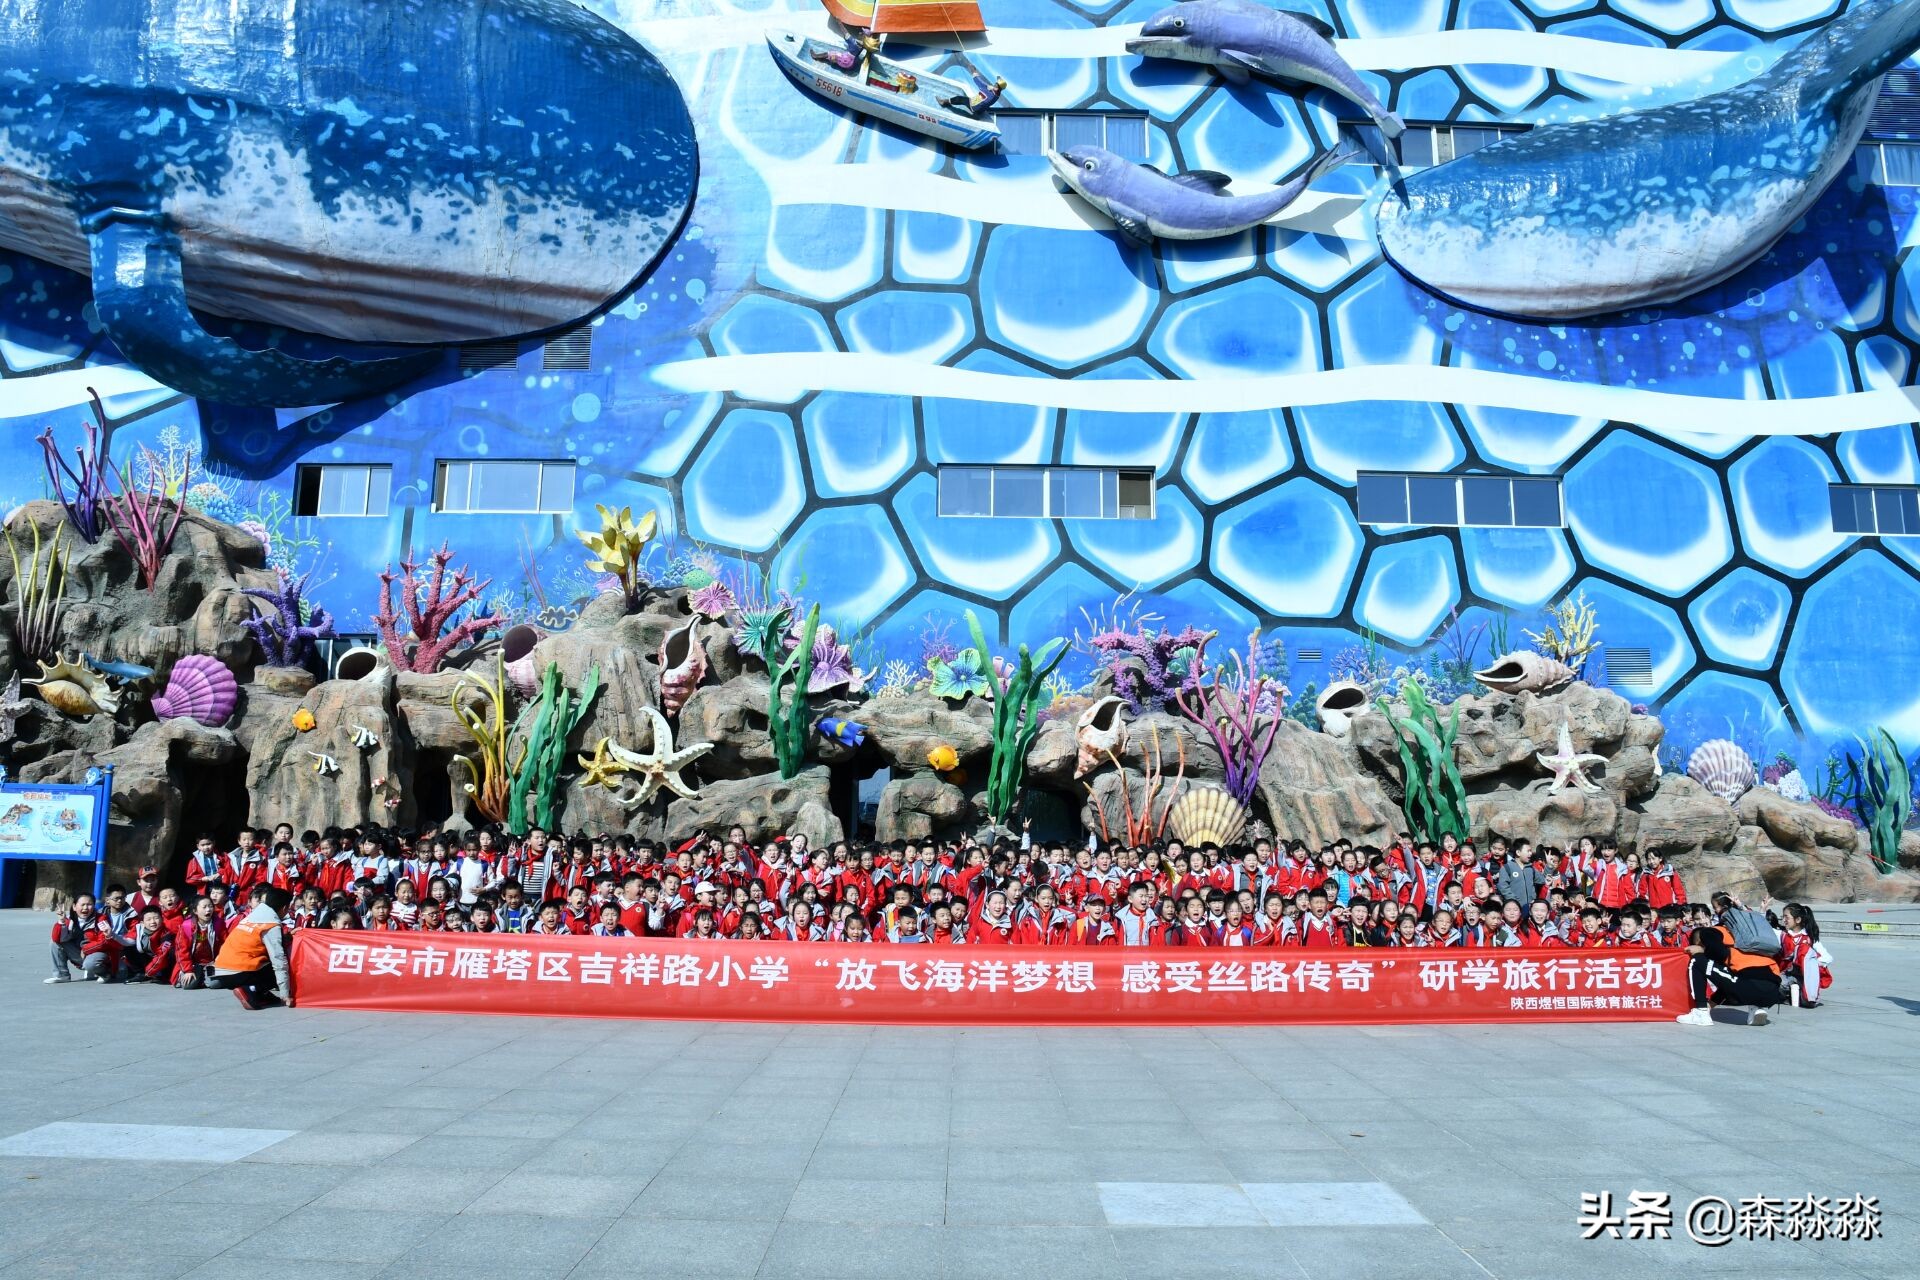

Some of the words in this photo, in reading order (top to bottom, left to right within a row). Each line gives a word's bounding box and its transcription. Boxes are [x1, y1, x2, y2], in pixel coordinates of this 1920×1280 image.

[328, 943, 788, 989] 西安市雁塔区吉祥路小学
[1419, 956, 1663, 992] 研学旅行活动
